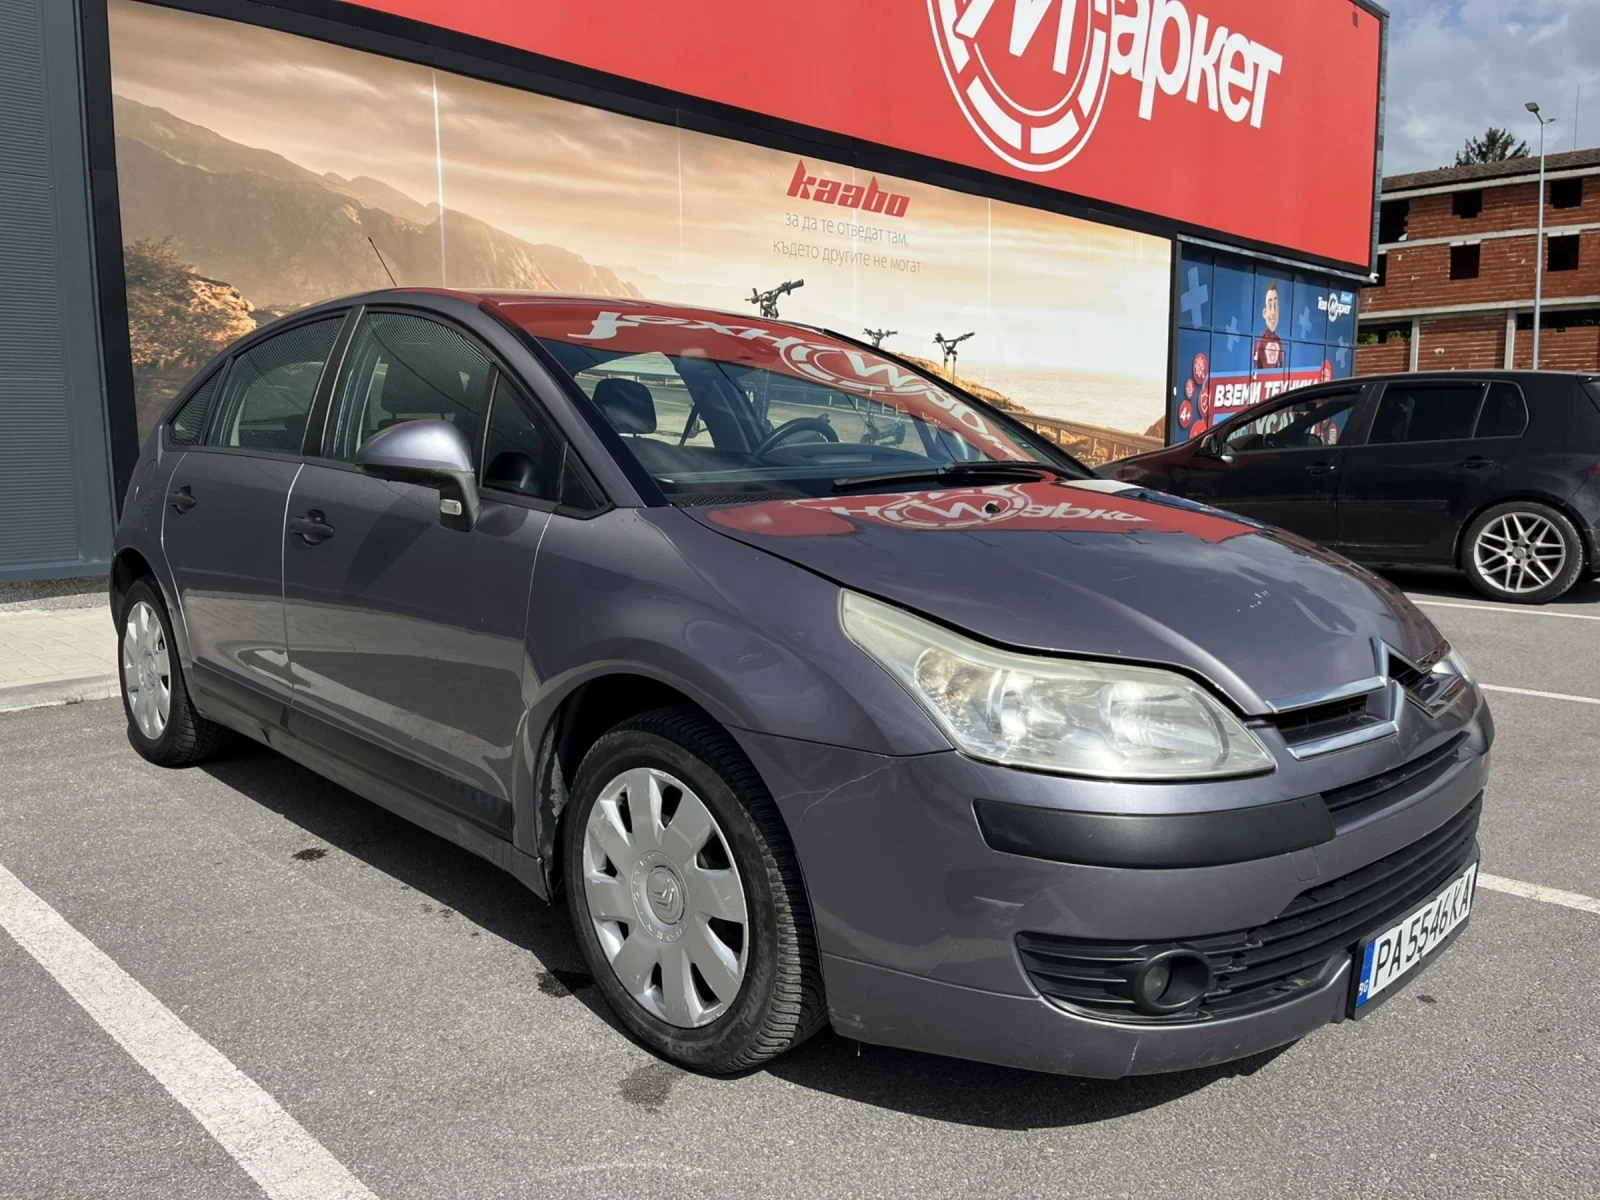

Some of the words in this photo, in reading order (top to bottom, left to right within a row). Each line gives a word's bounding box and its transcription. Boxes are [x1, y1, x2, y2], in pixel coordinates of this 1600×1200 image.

[787, 159, 910, 218] kaabo
[785, 212, 799, 227] за
[802, 215, 818, 231] да
[821, 218, 834, 233] те
[837, 222, 884, 242] отведат
[773, 240, 820, 259] където
[822, 247, 870, 267] другите
[873, 254, 887, 269] не
[890, 258, 922, 273] могат
[1214, 381, 1262, 407] ВЗЕМИ
[1264, 379, 1319, 400] ТЕХН
